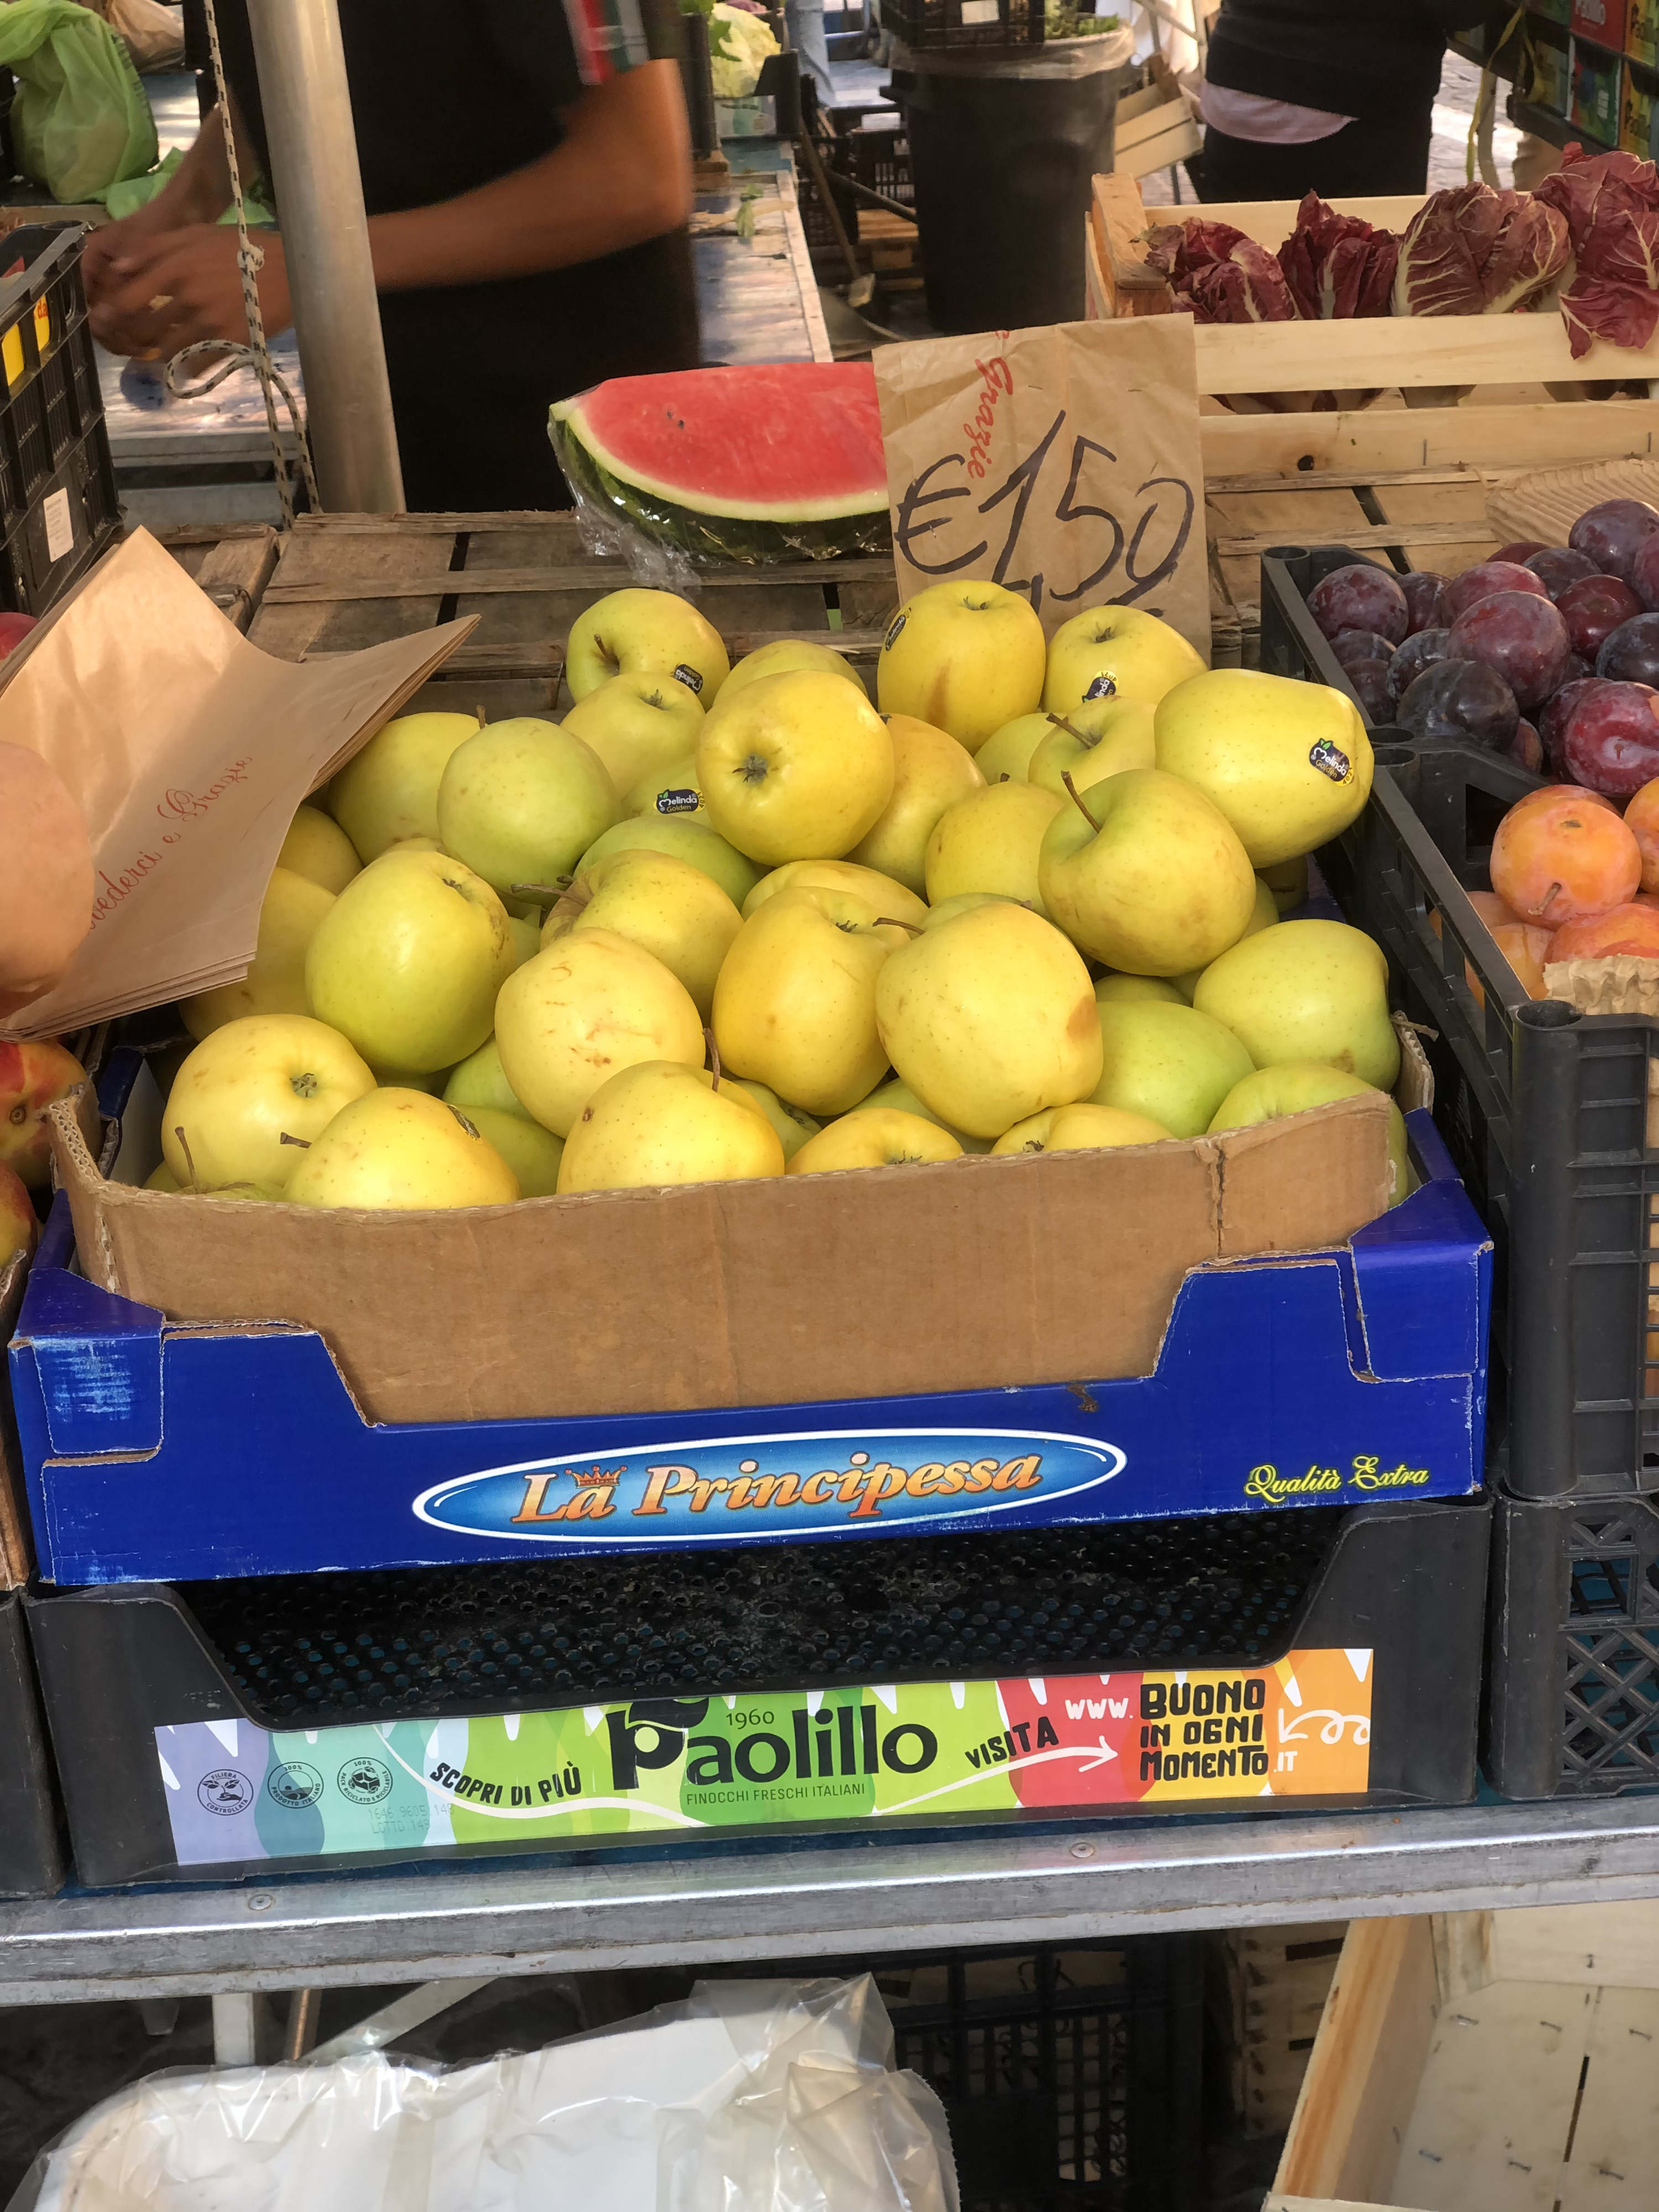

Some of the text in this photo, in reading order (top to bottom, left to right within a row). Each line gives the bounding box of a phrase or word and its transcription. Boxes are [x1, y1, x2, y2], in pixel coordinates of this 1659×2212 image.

[963, 357, 1014, 479] Grazie
[675, 669, 702, 691] Melinda
[1094, 679, 1110, 697] linda
[1313, 747, 1347, 776] Melinda
[1316, 759, 1338, 779] Golden
[156, 756, 253, 822] Grazie
[659, 794, 697, 807] Melinda
[162, 832, 181, 844] e
[632, 1452, 1044, 1517] Principessa
[1244, 1454, 1430, 1504] Qualità Extra
[1139, 1678, 1266, 1720] BUONO
[725, 1708, 775, 1730] 1960
[1140, 1713, 1264, 1748] IN OGNI
[964, 1716, 1060, 1769] VISITA
[211, 1772, 237, 1780] FILIERA
[1140, 1744, 1269, 1781] MOMENTO
[271, 1782, 321, 1806] PRODOTTO ITALIANO
[343, 1787, 371, 1802] RICICLATO
[375, 1770, 390, 1798] RICICLABILE
[429, 1760, 582, 1806] SCOPRI DI PIÙ
[686, 1782, 865, 1806] FINOCCHI FRESCHI ITALIANI
[206, 1799, 249, 1813] CONTROLLATA
